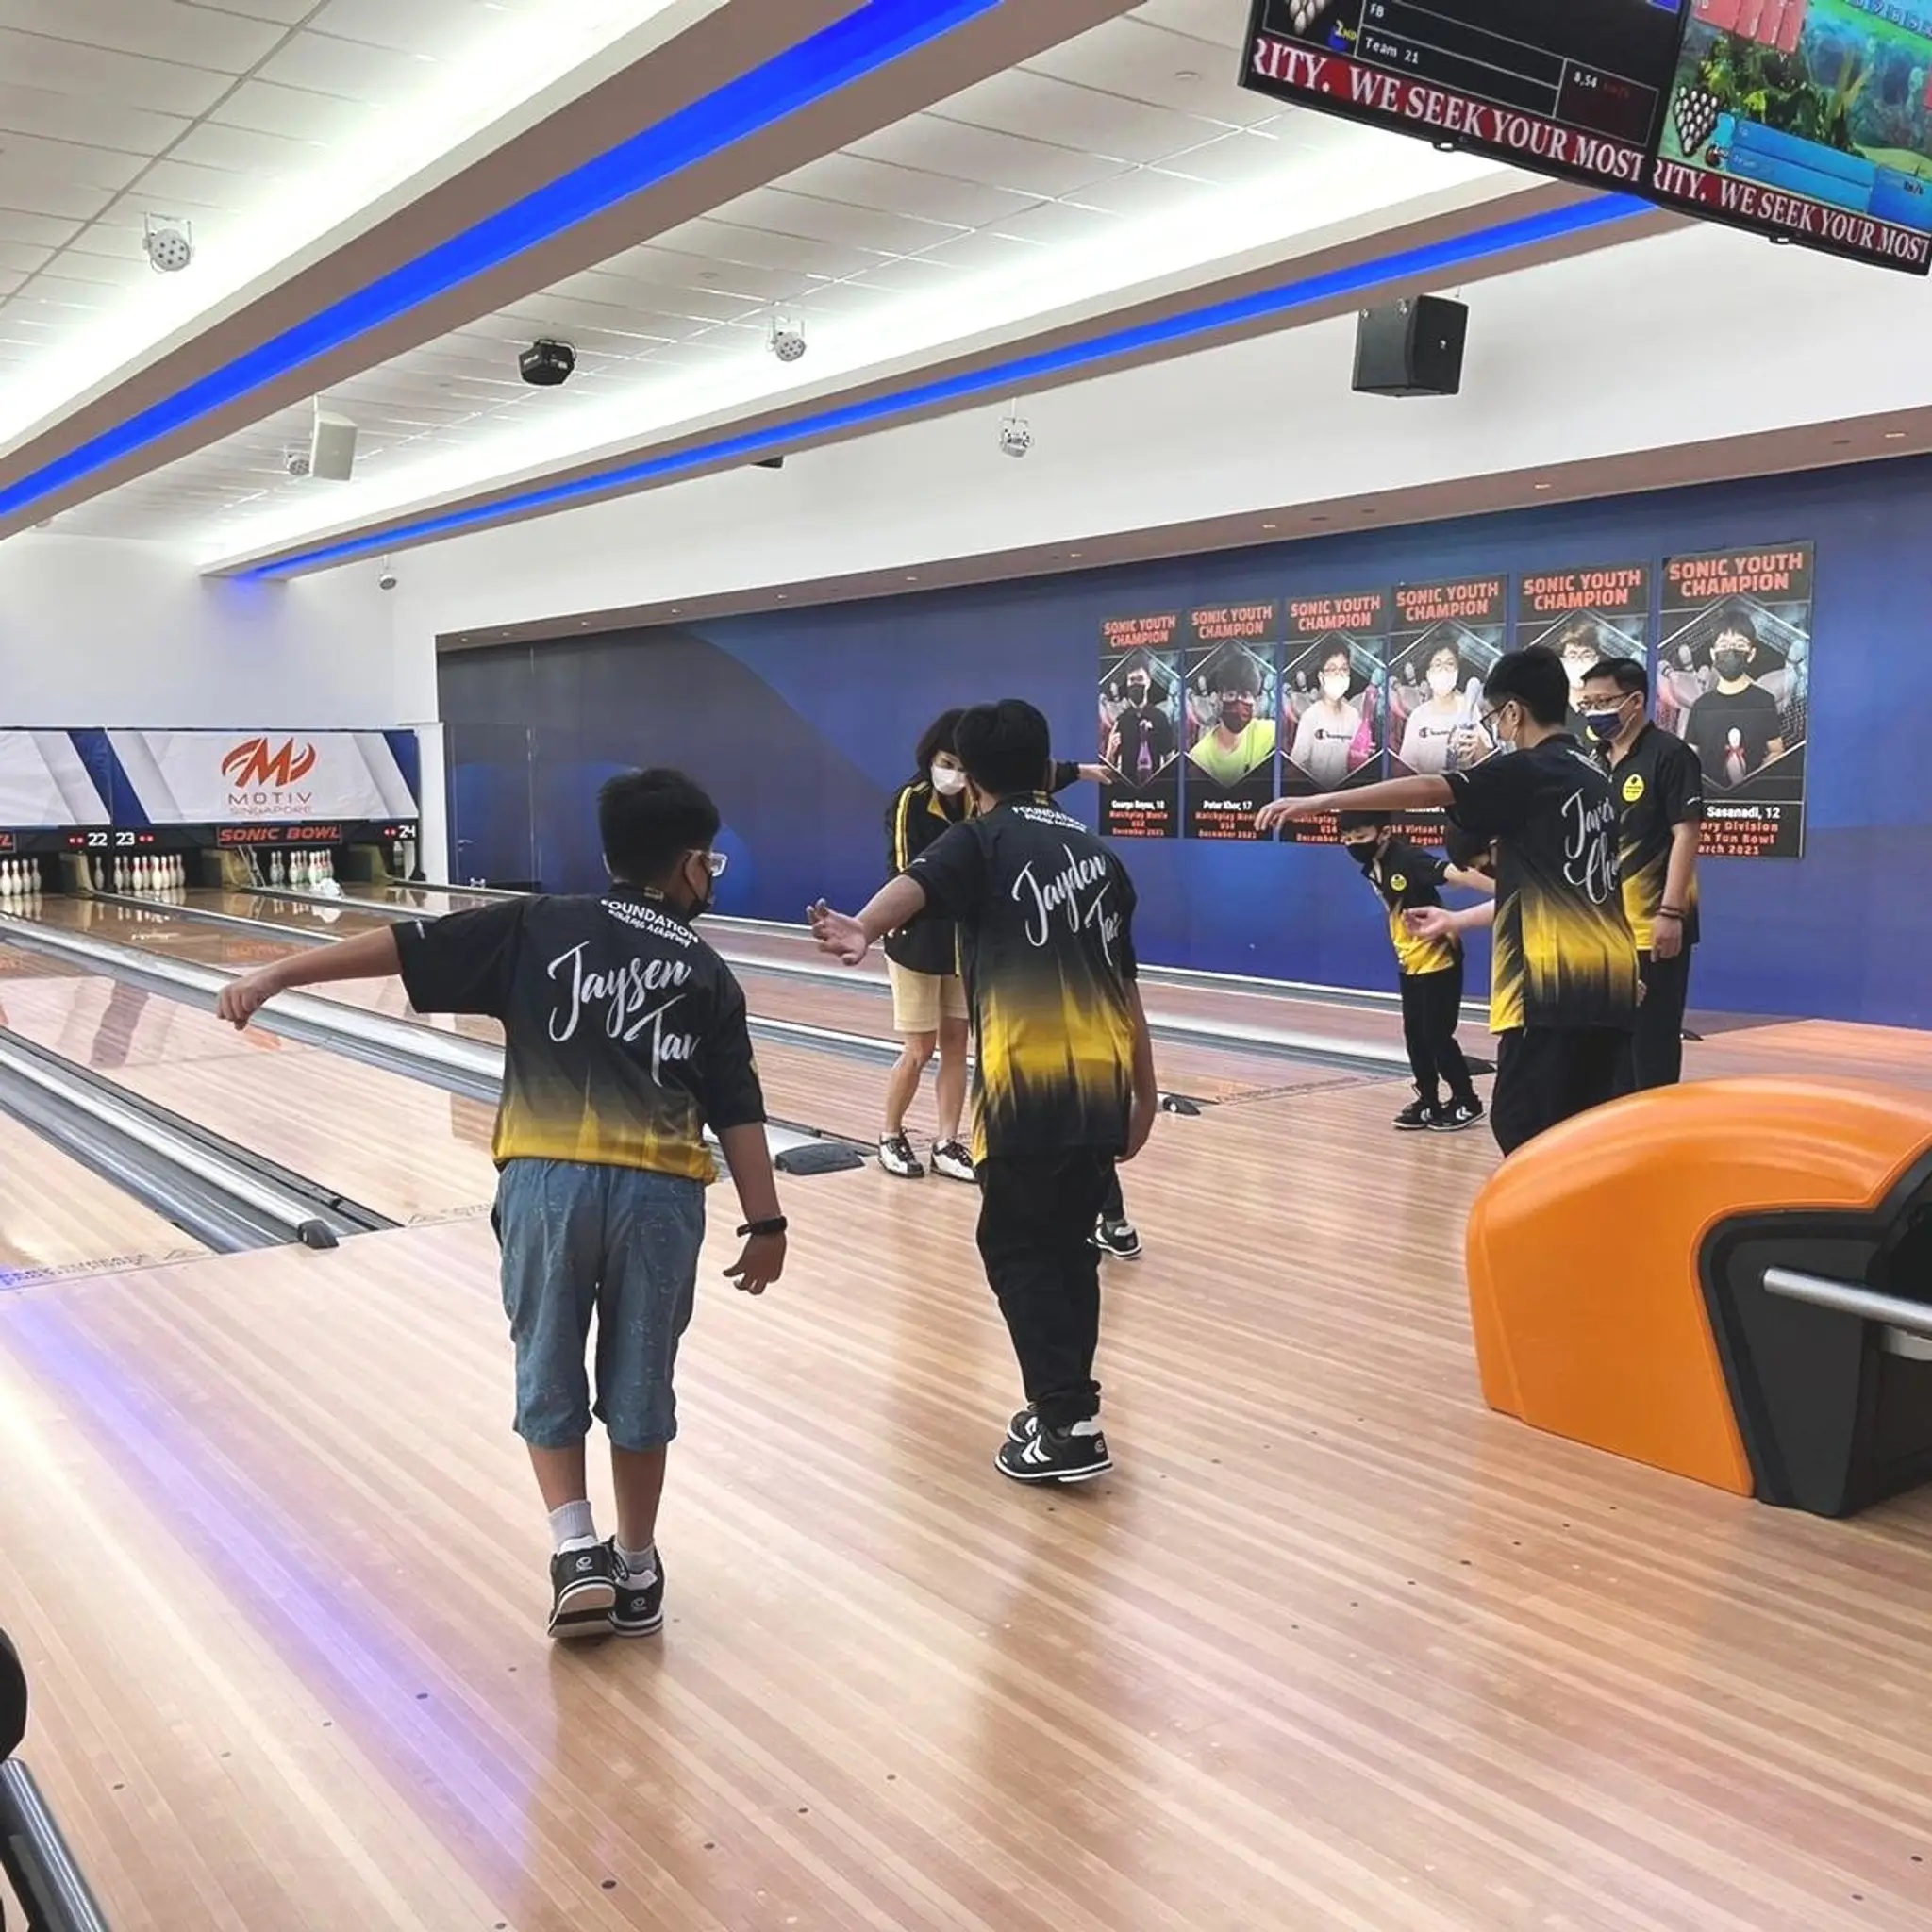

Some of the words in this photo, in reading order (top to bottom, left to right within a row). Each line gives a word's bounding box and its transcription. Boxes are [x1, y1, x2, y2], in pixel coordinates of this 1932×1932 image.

[1366, 36, 1398, 58] Team
[1404, 49, 1419, 65] 21
[1349, 65, 1401, 113] WE
[1404, 87, 1486, 139] SEEK
[1487, 111, 1568, 160] YOUR
[1568, 139, 1644, 183] MOST
[1718, 177, 1758, 213] WE
[1755, 192, 1813, 234] SEEK
[1816, 209, 1876, 250] YOUR
[1668, 558, 1728, 581] SONIC
[1733, 552, 1803, 574] YOUTH
[1523, 575, 1576, 596] SONIC
[1579, 569, 1641, 590] YOUTH
[1680, 573, 1790, 597] CHAMPION
[1395, 586, 1443, 607] SONIC
[1445, 581, 1499, 601] YOUTH
[1533, 588, 1629, 612] CHAMPION
[1191, 609, 1224, 626] SONIC
[1224, 605, 1273, 624] YOUTH
[1290, 600, 1330, 618] SONIC
[1332, 596, 1381, 614] YOUTH
[1405, 599, 1489, 622] CHAMPION
[1104, 619, 1136, 635] SONIC
[1139, 615, 1175, 632] YOUTH
[1198, 622, 1264, 640] CHAMPION
[1298, 613, 1373, 632] CHAMPION
[1110, 629, 1169, 648] CHAMPION
[228, 792, 313, 805] MOTIV
[1764, 807, 1781, 820] 12
[220, 828, 280, 842] SONIC
[286, 826, 341, 841] BOWL
[399, 825, 416, 838] 24
[1724, 821, 1779, 832] Division
[88, 832, 108, 847] 22
[115, 832, 135, 847] 23
[1741, 834, 1774, 844] Bowl
[1727, 845, 1760, 855] 2021
[1011, 843, 1106, 947] Jayden
[547, 940, 692, 1042] Jaysen
